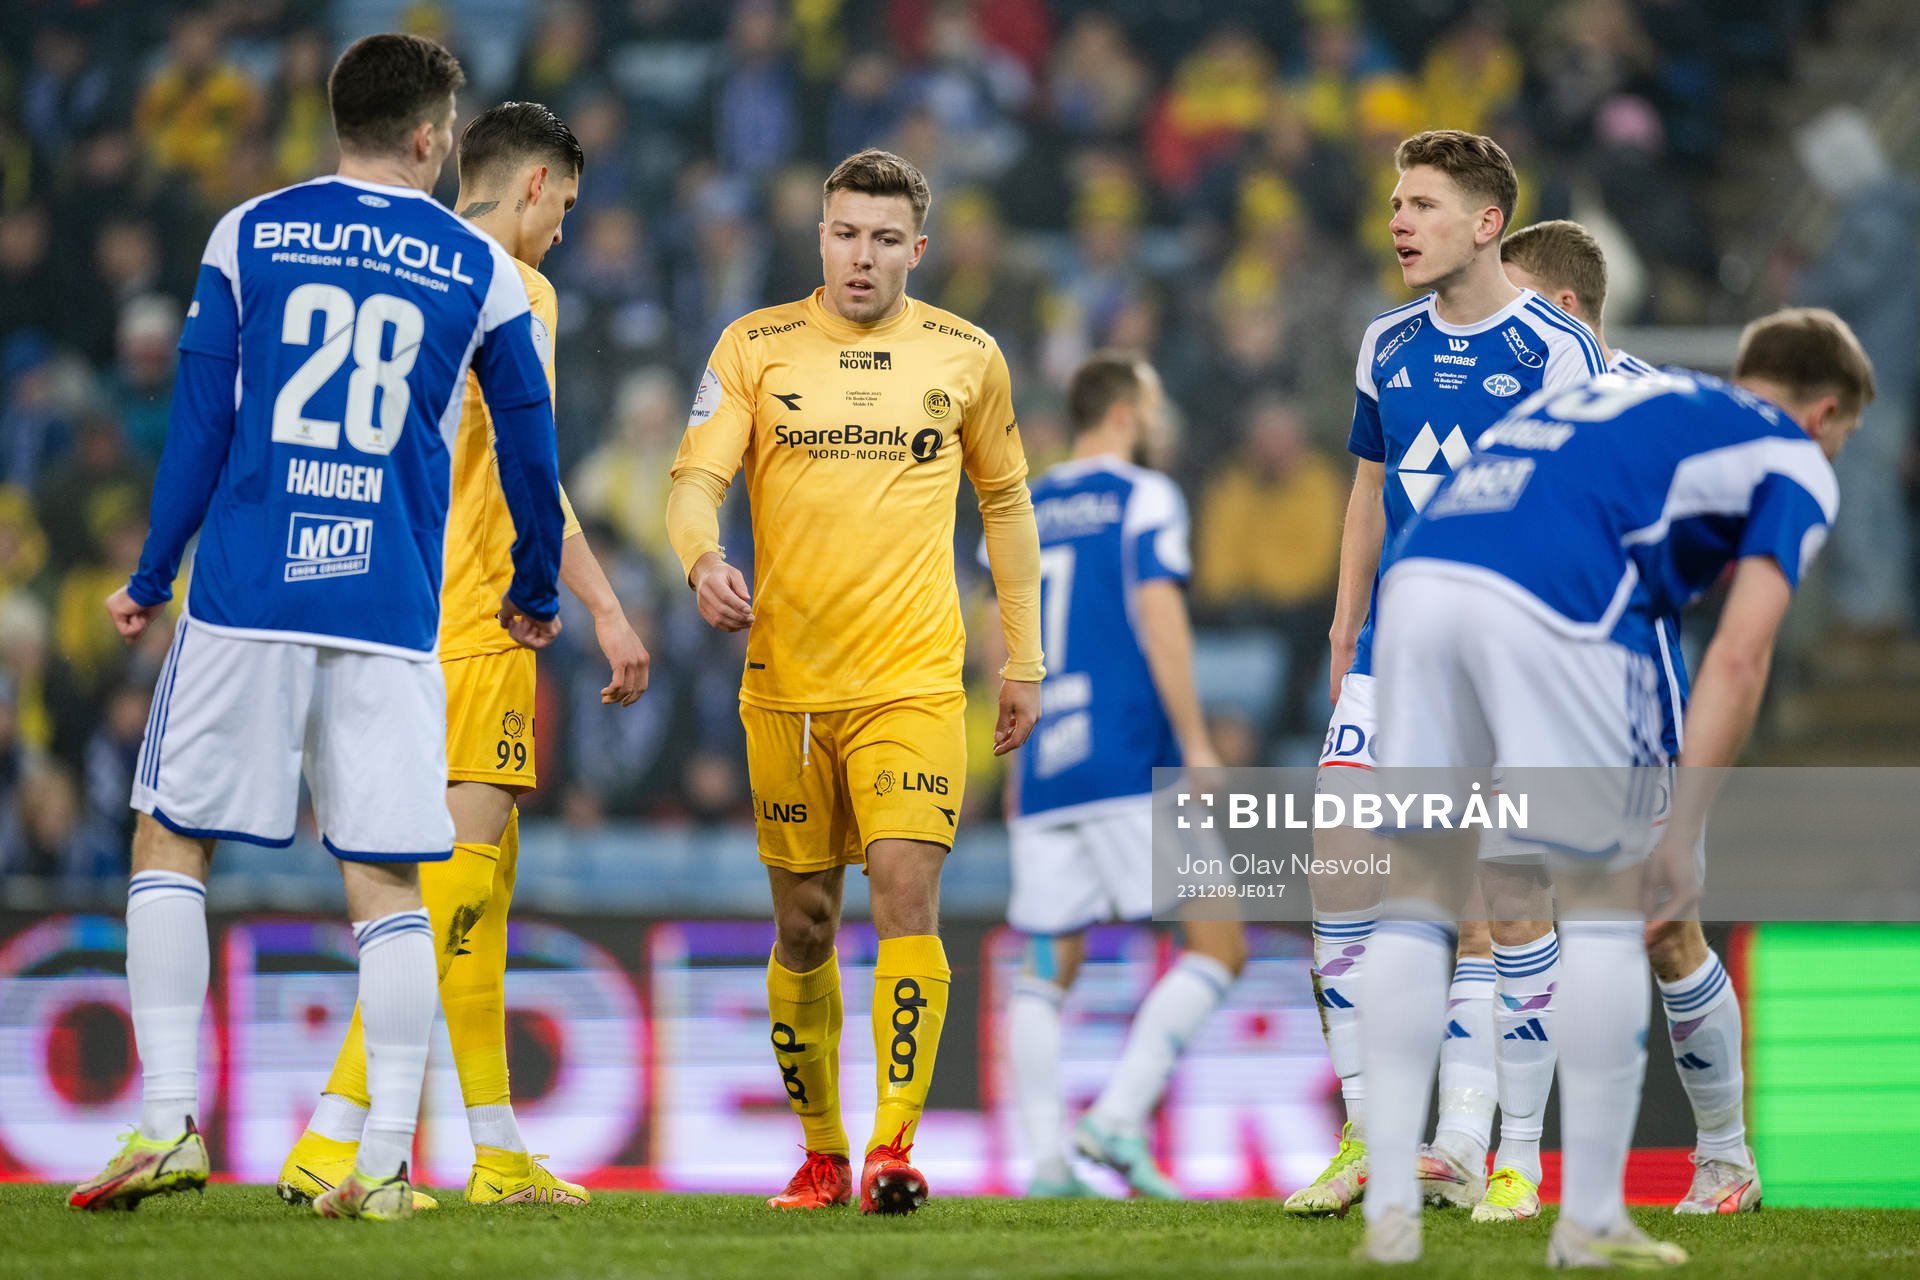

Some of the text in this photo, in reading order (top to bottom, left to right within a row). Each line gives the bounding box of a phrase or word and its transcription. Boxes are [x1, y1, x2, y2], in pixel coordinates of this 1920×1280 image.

[253, 222, 474, 286] BRUNVOLL
[272, 252, 449, 293] PRECISION IS OUR PASSION
[761, 320, 807, 337] Elkem
[938, 325, 986, 349] Elkem
[840, 351, 872, 359] ACTION
[840, 359, 872, 370] NOW
[1434, 354, 1476, 367] wenaas
[272, 283, 424, 456] 28
[775, 425, 909, 448] SpareBank
[808, 450, 907, 462] NORD-NORGE
[286, 459, 384, 504] HAUGEN
[299, 520, 371, 559] MOT
[497, 740, 527, 772] 99
[903, 772, 949, 795] LNS
[763, 801, 807, 823] LNS
[890, 977, 928, 1083] coop
